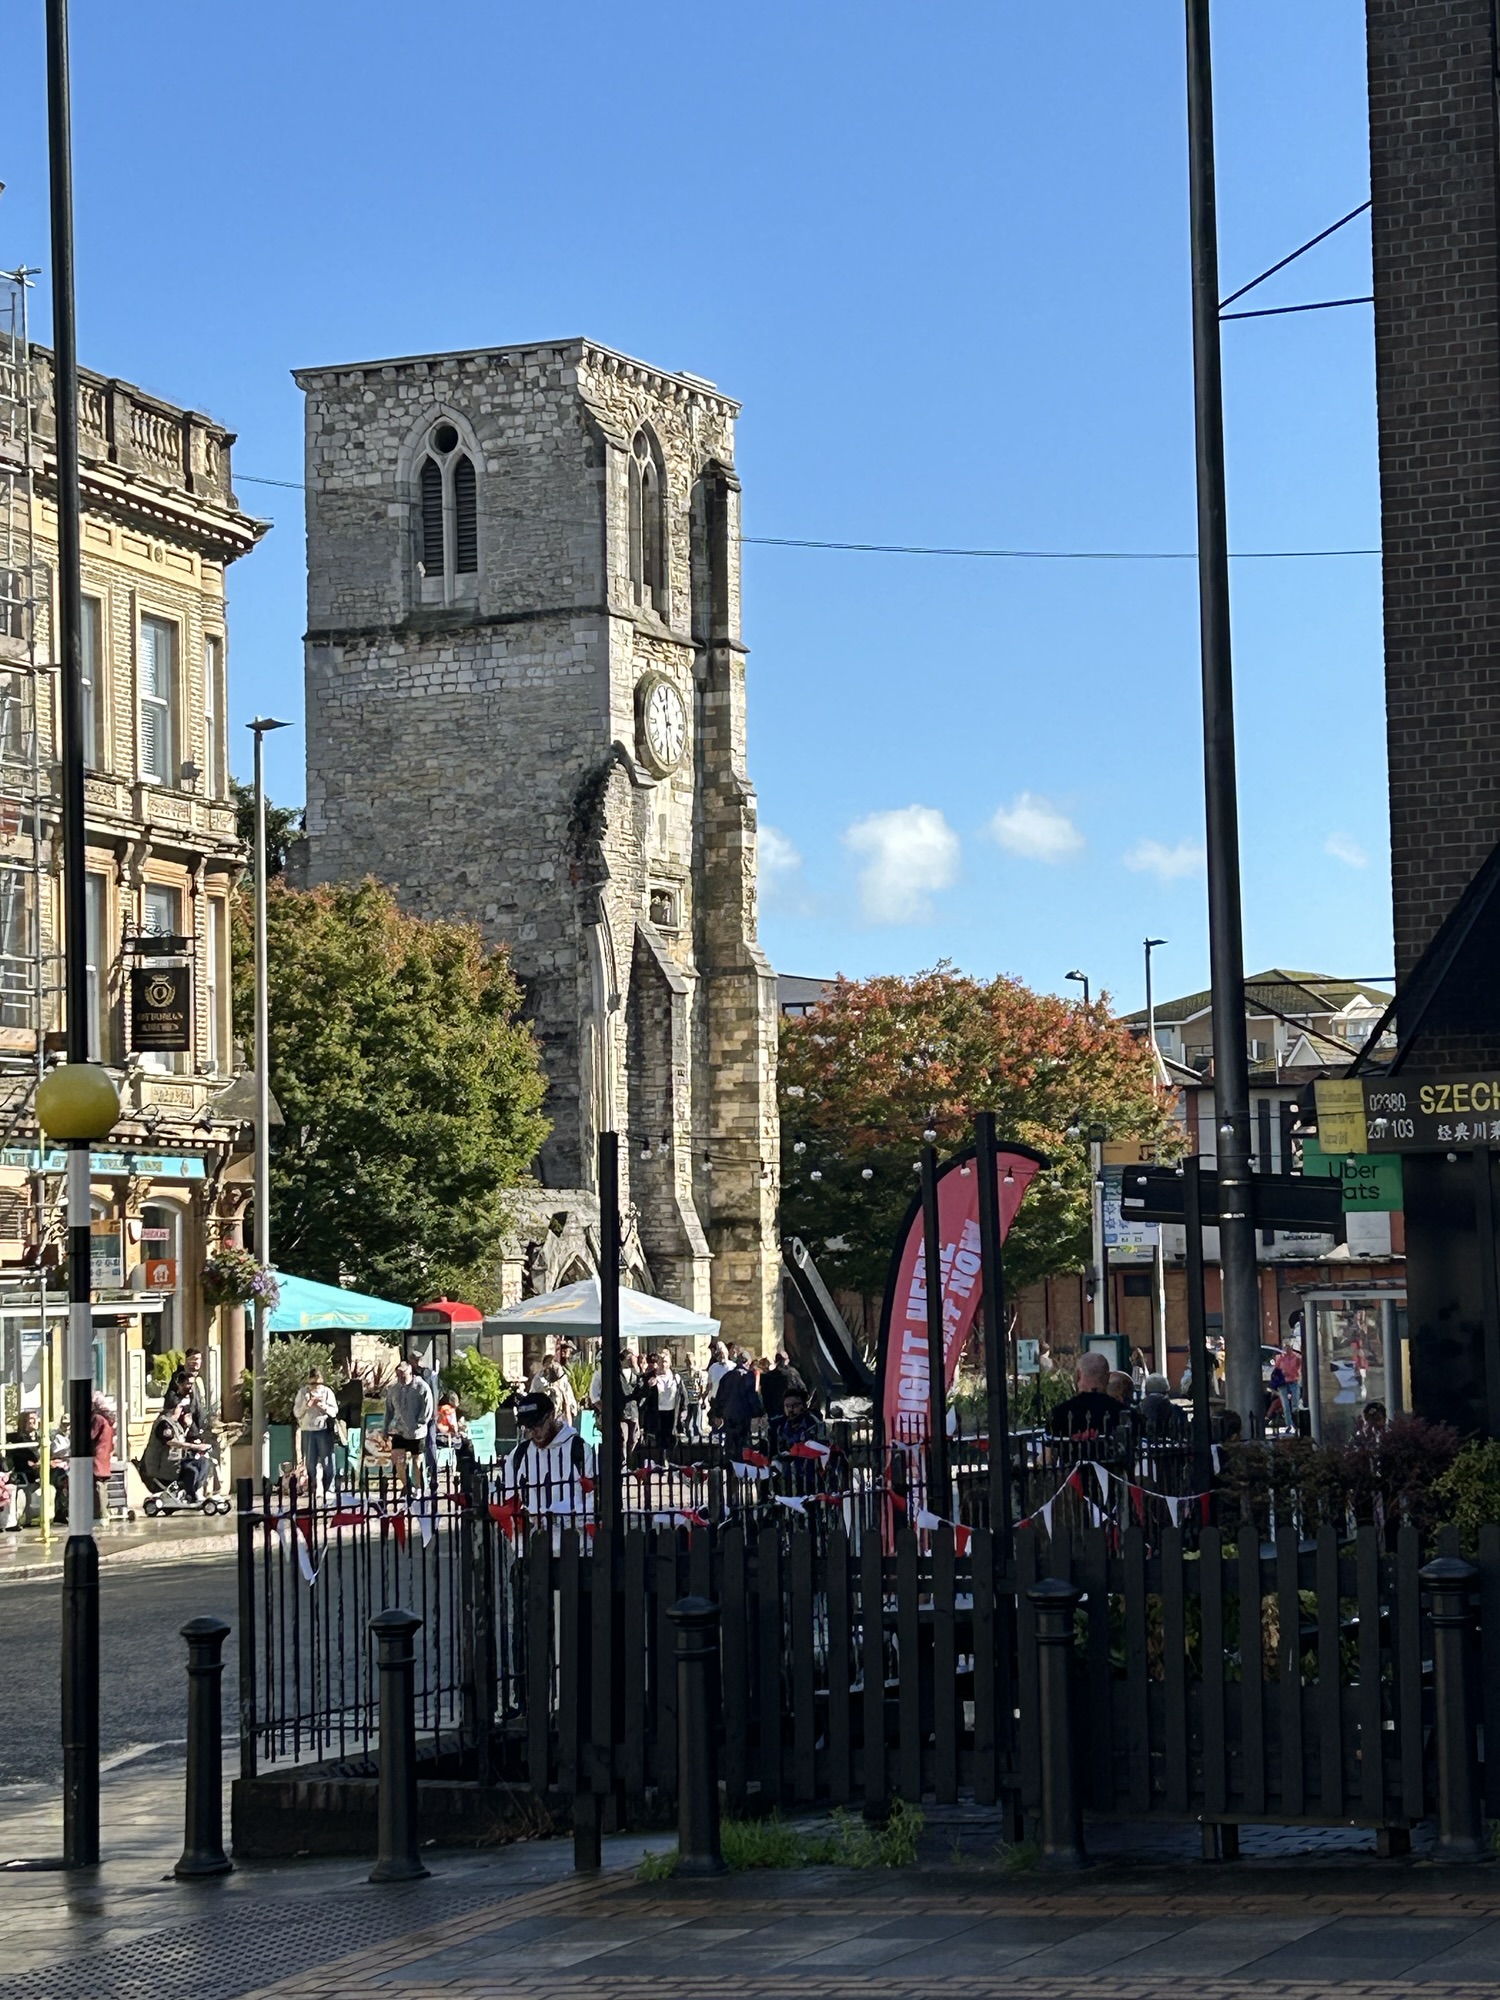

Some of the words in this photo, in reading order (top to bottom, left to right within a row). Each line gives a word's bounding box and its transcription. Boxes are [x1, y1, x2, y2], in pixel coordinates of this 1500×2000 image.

[1392, 1119, 1415, 1139] 103
[1329, 1161, 1380, 1179] Uber
[1342, 1184, 1380, 1200] ats
[949, 1219, 982, 1298] NOW
[897, 1331, 930, 1435] RIGHT
